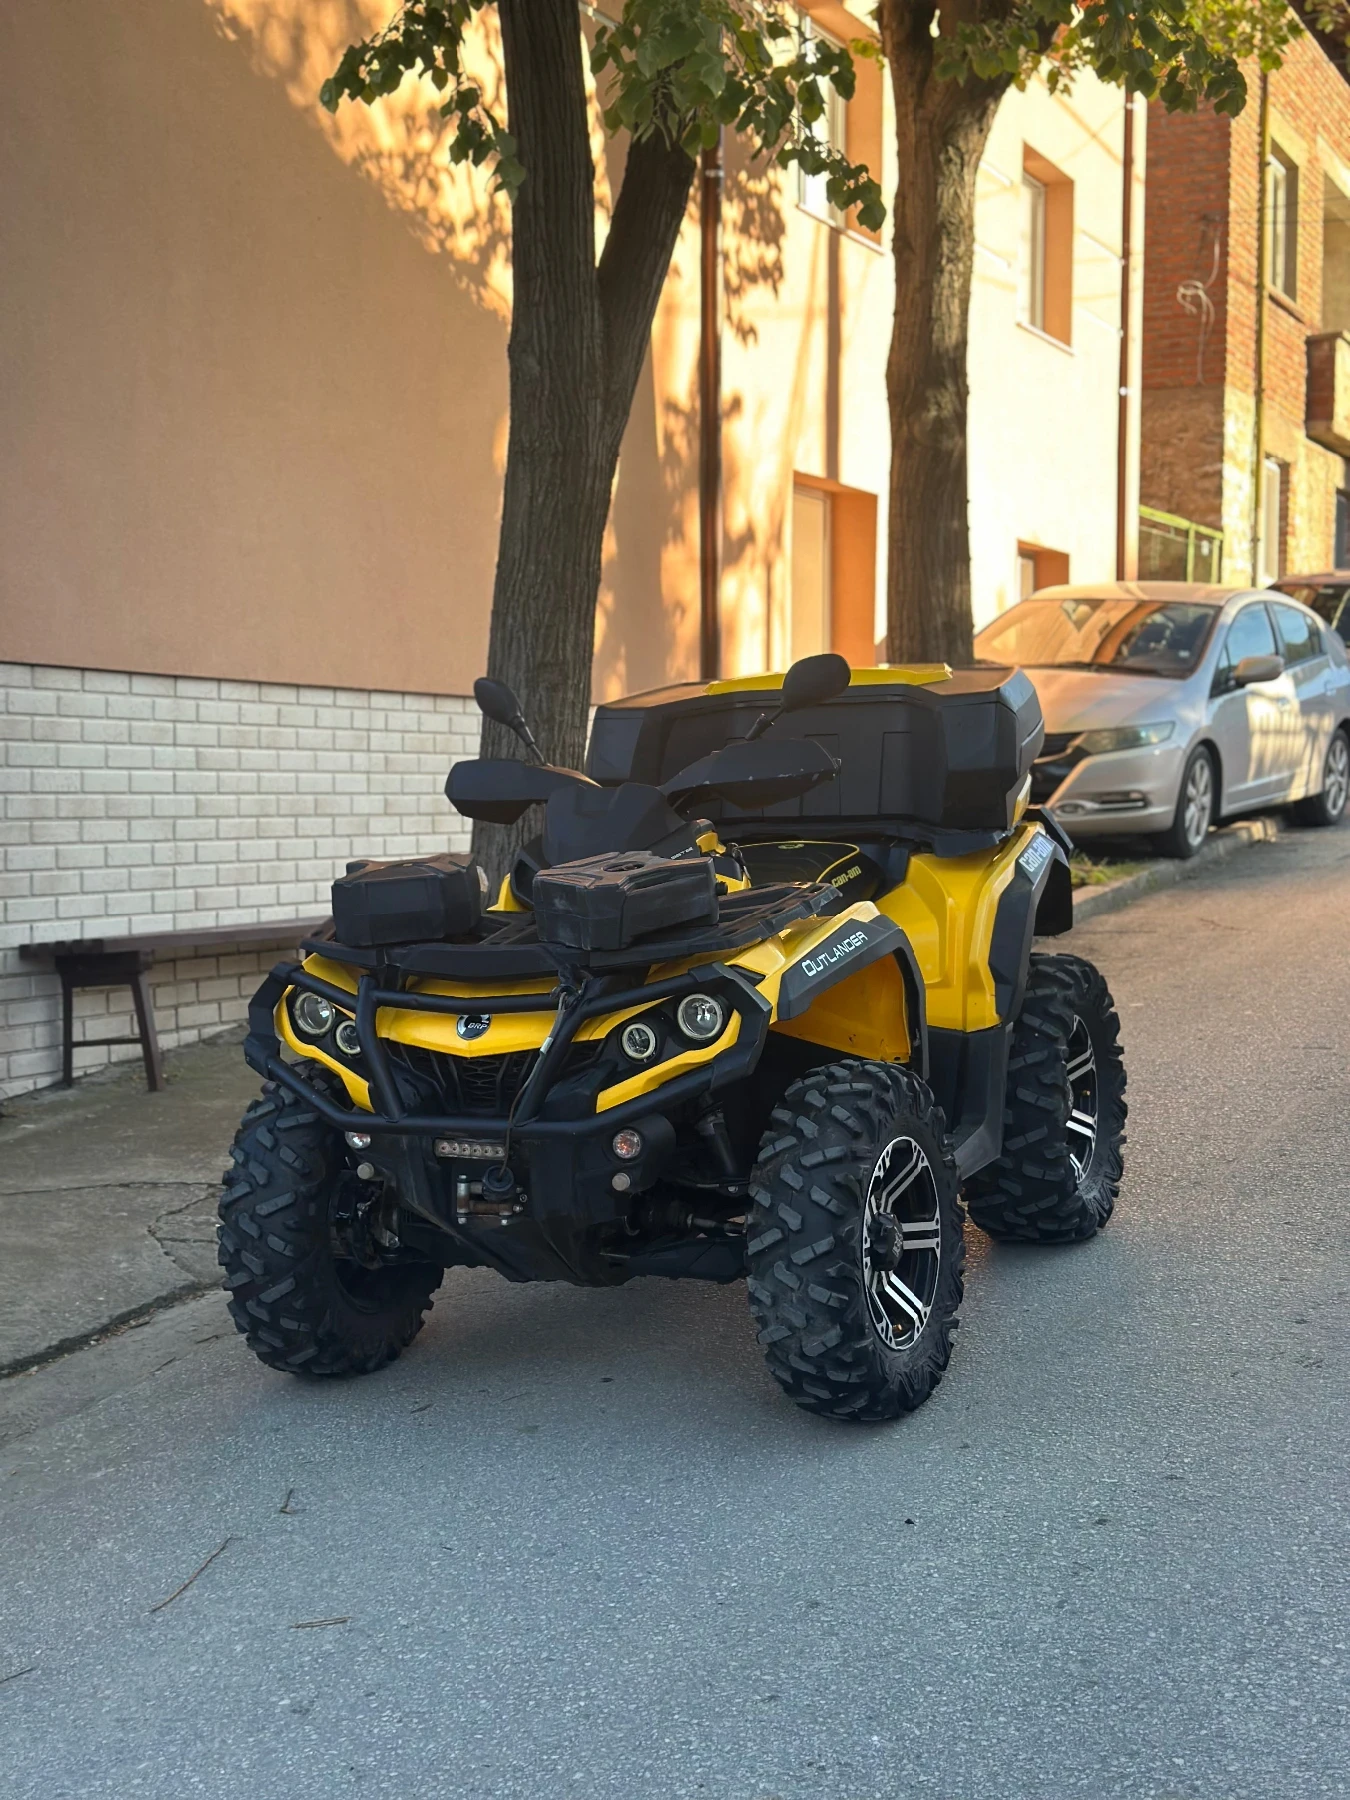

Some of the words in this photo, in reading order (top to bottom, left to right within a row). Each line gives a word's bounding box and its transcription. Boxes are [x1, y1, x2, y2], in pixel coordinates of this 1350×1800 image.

[1018, 836, 1053, 873] can-am
[831, 865, 862, 888] can-am
[801, 931, 869, 977] OUTLANDER
